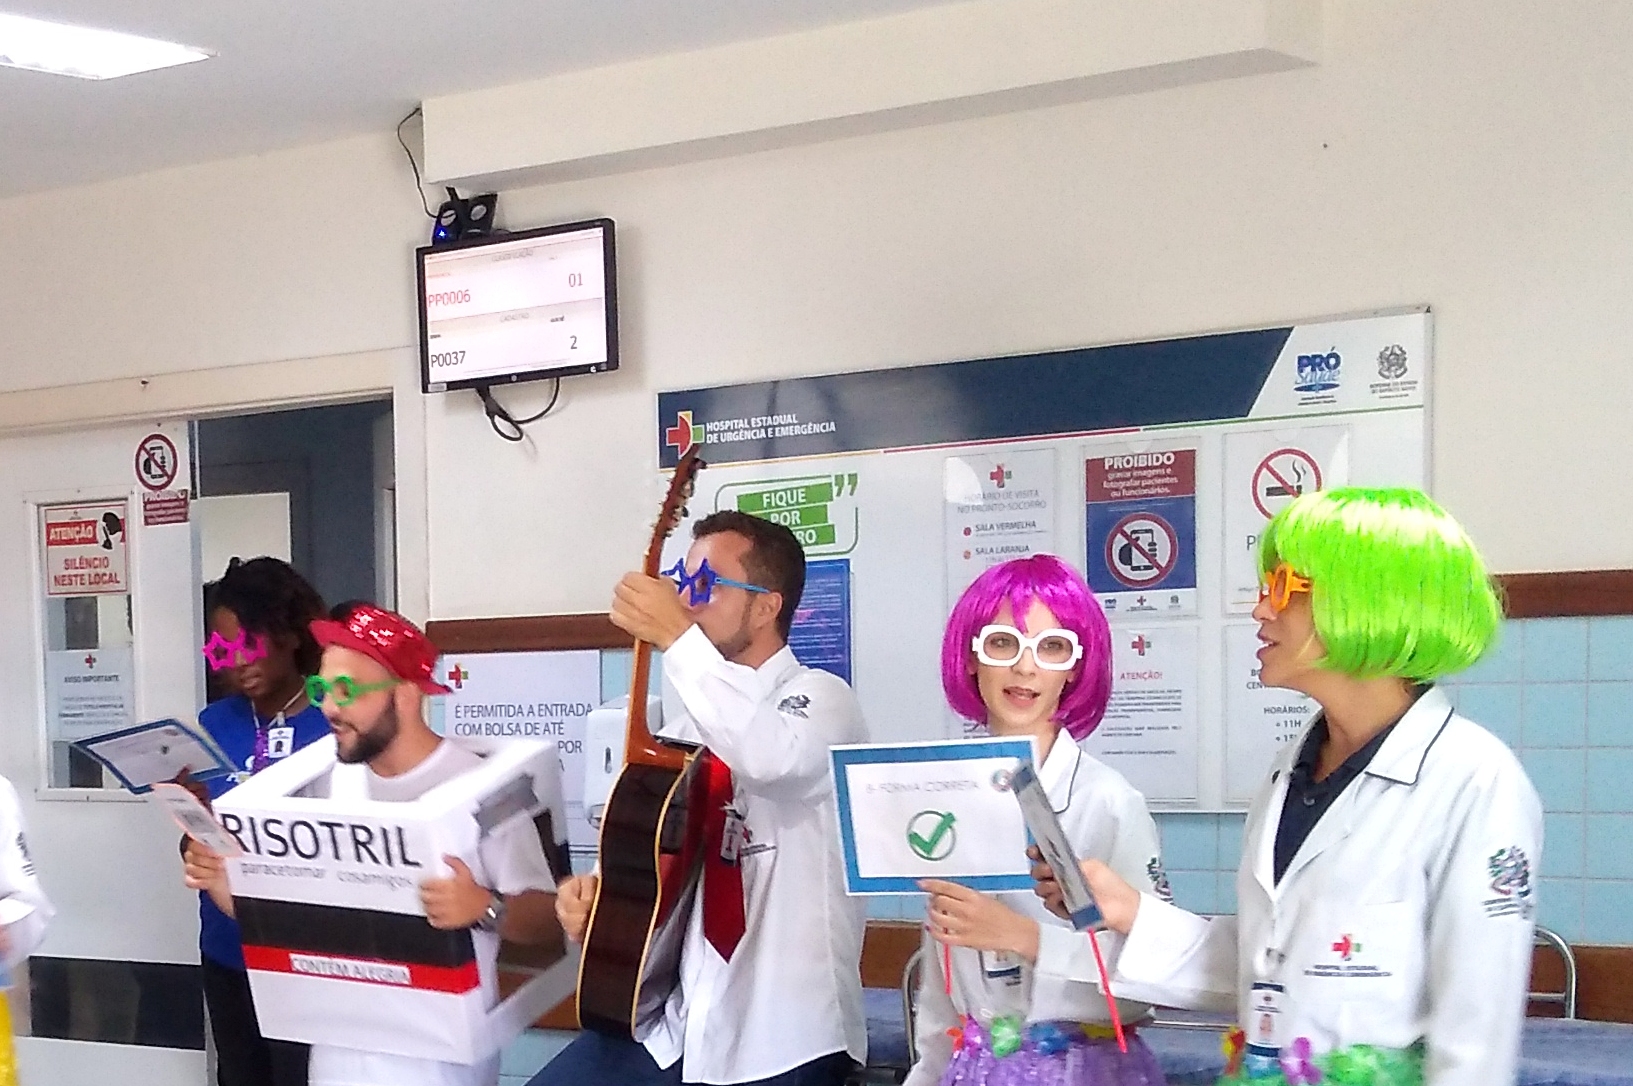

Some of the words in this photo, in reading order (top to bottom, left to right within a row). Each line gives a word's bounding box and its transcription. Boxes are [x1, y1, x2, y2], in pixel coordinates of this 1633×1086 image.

[568, 272, 584, 288] 01
[428, 289, 471, 308] PP0006
[570, 335, 579, 350] 2
[430, 351, 467, 368] P0037
[1297, 346, 1341, 373] PRÓ
[706, 419, 750, 432] HOSPITAL
[751, 413, 799, 428] ESTADUAL
[706, 433, 719, 444] DE
[720, 427, 767, 443] URGÊNCIA
[768, 427, 774, 438] E
[775, 421, 836, 437] EMERGÊNCIA
[1104, 452, 1176, 470] PROIBIDO
[1108, 470, 1132, 480] gravar
[1132, 468, 1165, 479] imagens
[1166, 467, 1172, 475] e
[1103, 478, 1140, 489] fotografar
[1141, 476, 1179, 487] pacientes
[762, 488, 807, 508] FIQUE
[1015, 489, 1040, 499] VISITA
[1110, 489, 1121, 498] ou
[957, 505, 971, 514] NO
[971, 500, 1047, 513] PRONTO-SOCORRO
[770, 510, 801, 525] POR
[49, 523, 94, 543] ATENÇÃO
[975, 522, 995, 532] SALA
[995, 520, 1037, 531] VERMELHA
[975, 546, 994, 555] SALA
[995, 545, 1030, 554] LARANJA
[64, 555, 110, 570] SILÊNCIO
[54, 573, 86, 587] NESTE
[88, 572, 121, 586] LOCAL
[1120, 670, 1163, 681] ATENÇÃO!
[454, 703, 461, 718] É
[463, 704, 525, 719] PERMITIDA
[526, 704, 536, 717] A
[537, 703, 593, 717] ENTRADA
[454, 723, 482, 736] COM
[485, 722, 522, 736] BOLSA
[524, 722, 540, 736] DE
[542, 719, 564, 735] ATÉ
[1283, 719, 1302, 728] 11H
[557, 740, 582, 754] POR
[221, 813, 422, 868] RISOTRIL
